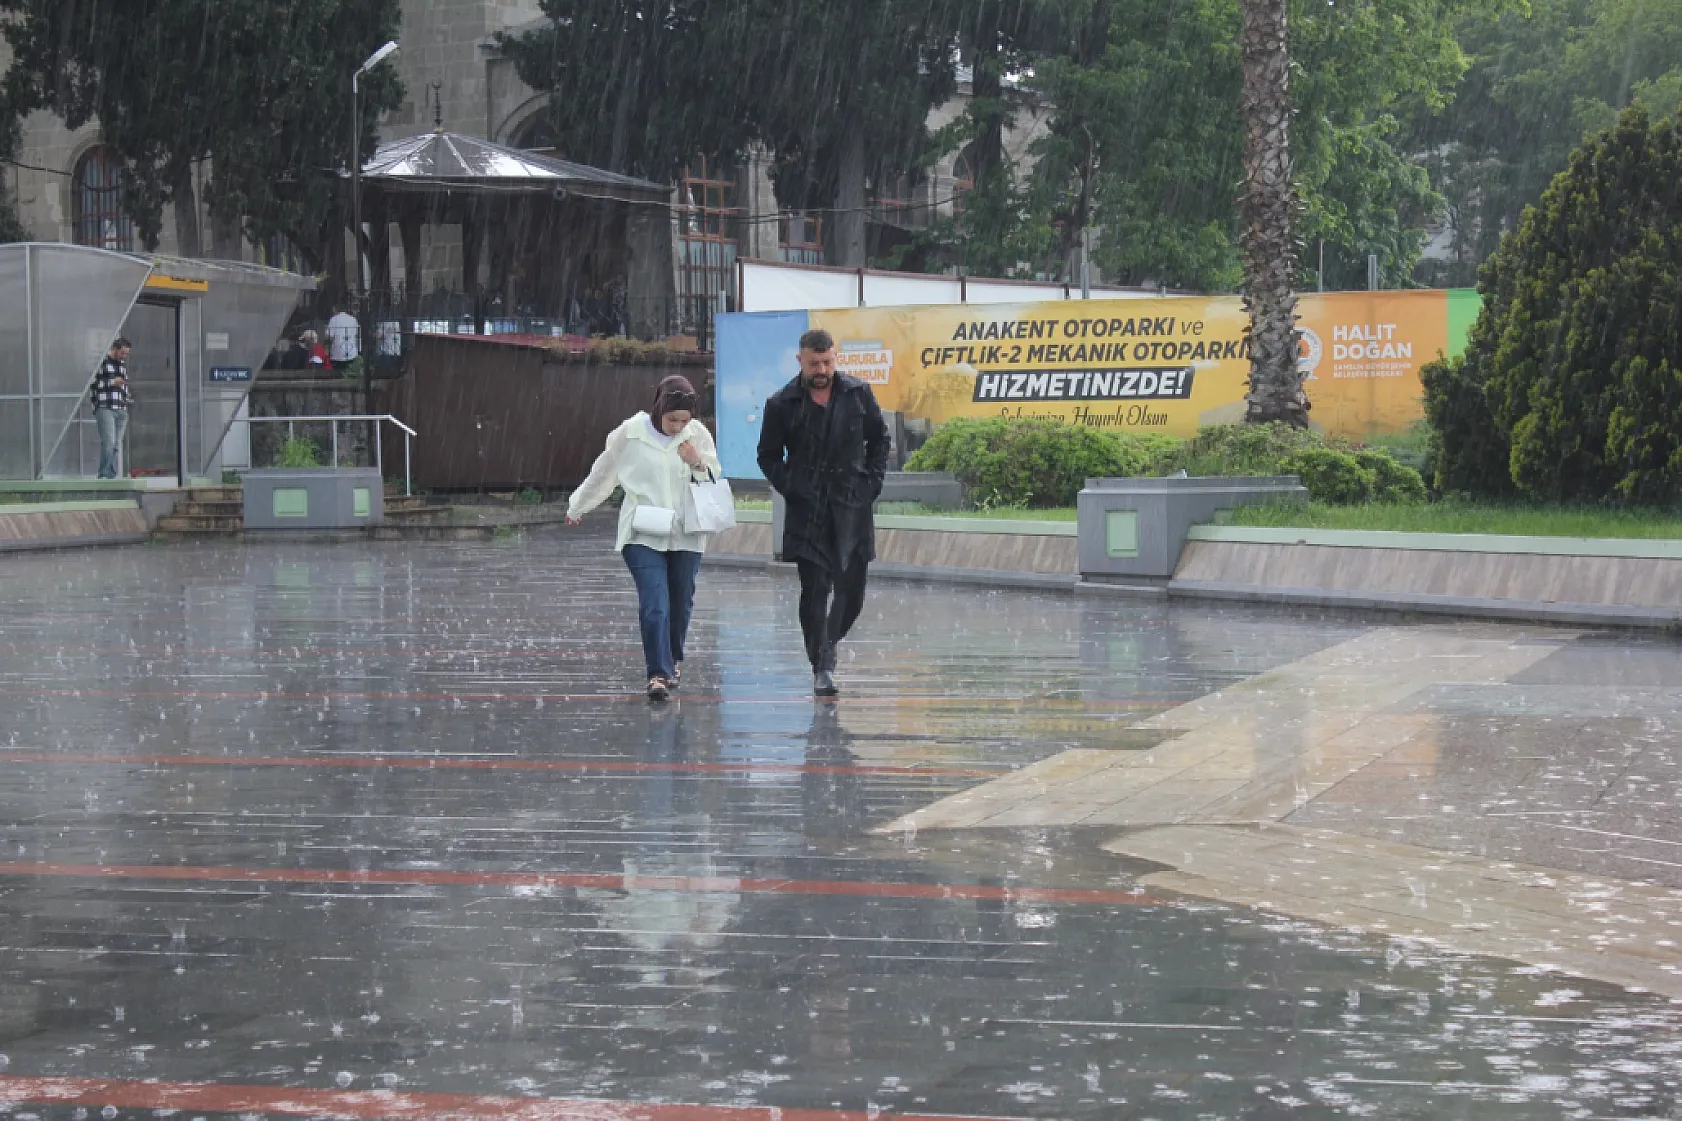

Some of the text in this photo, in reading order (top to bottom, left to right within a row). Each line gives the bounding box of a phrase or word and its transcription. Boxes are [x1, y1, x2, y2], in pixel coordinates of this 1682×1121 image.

[952, 317, 1204, 341] ANAKENT OTOPARKI ve
[921, 345, 1022, 369] ÇİFTLİK-2
[1026, 342, 1129, 363] MEKANİK
[1333, 341, 1412, 359] DOĞAN
[979, 371, 1185, 397] HİZMETİNİZDE!
[1126, 404, 1168, 426] Olsun
